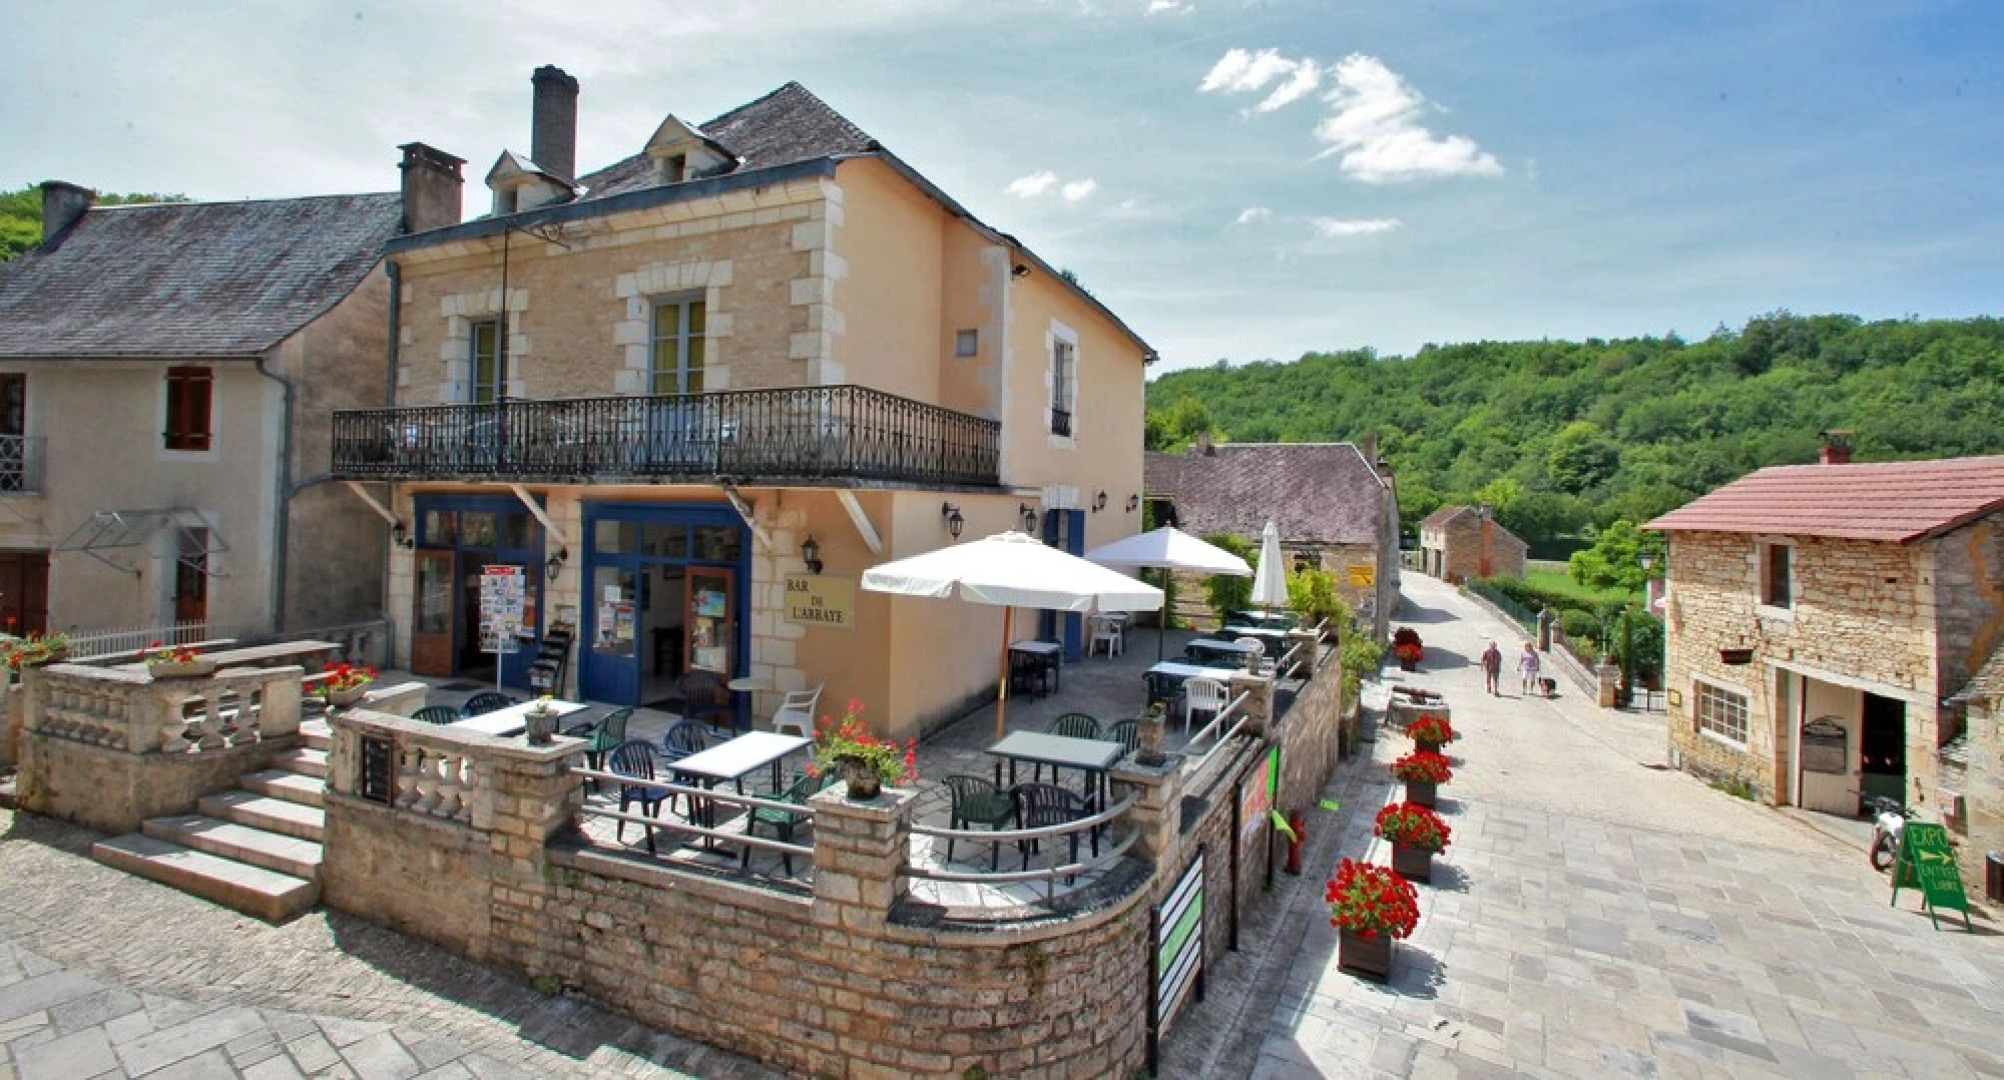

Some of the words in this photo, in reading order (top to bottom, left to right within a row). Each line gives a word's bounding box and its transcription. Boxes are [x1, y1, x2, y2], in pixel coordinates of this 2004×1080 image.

[787, 579, 809, 592] BAR
[811, 595, 823, 606] DE
[1910, 825, 1949, 847] EXPO
